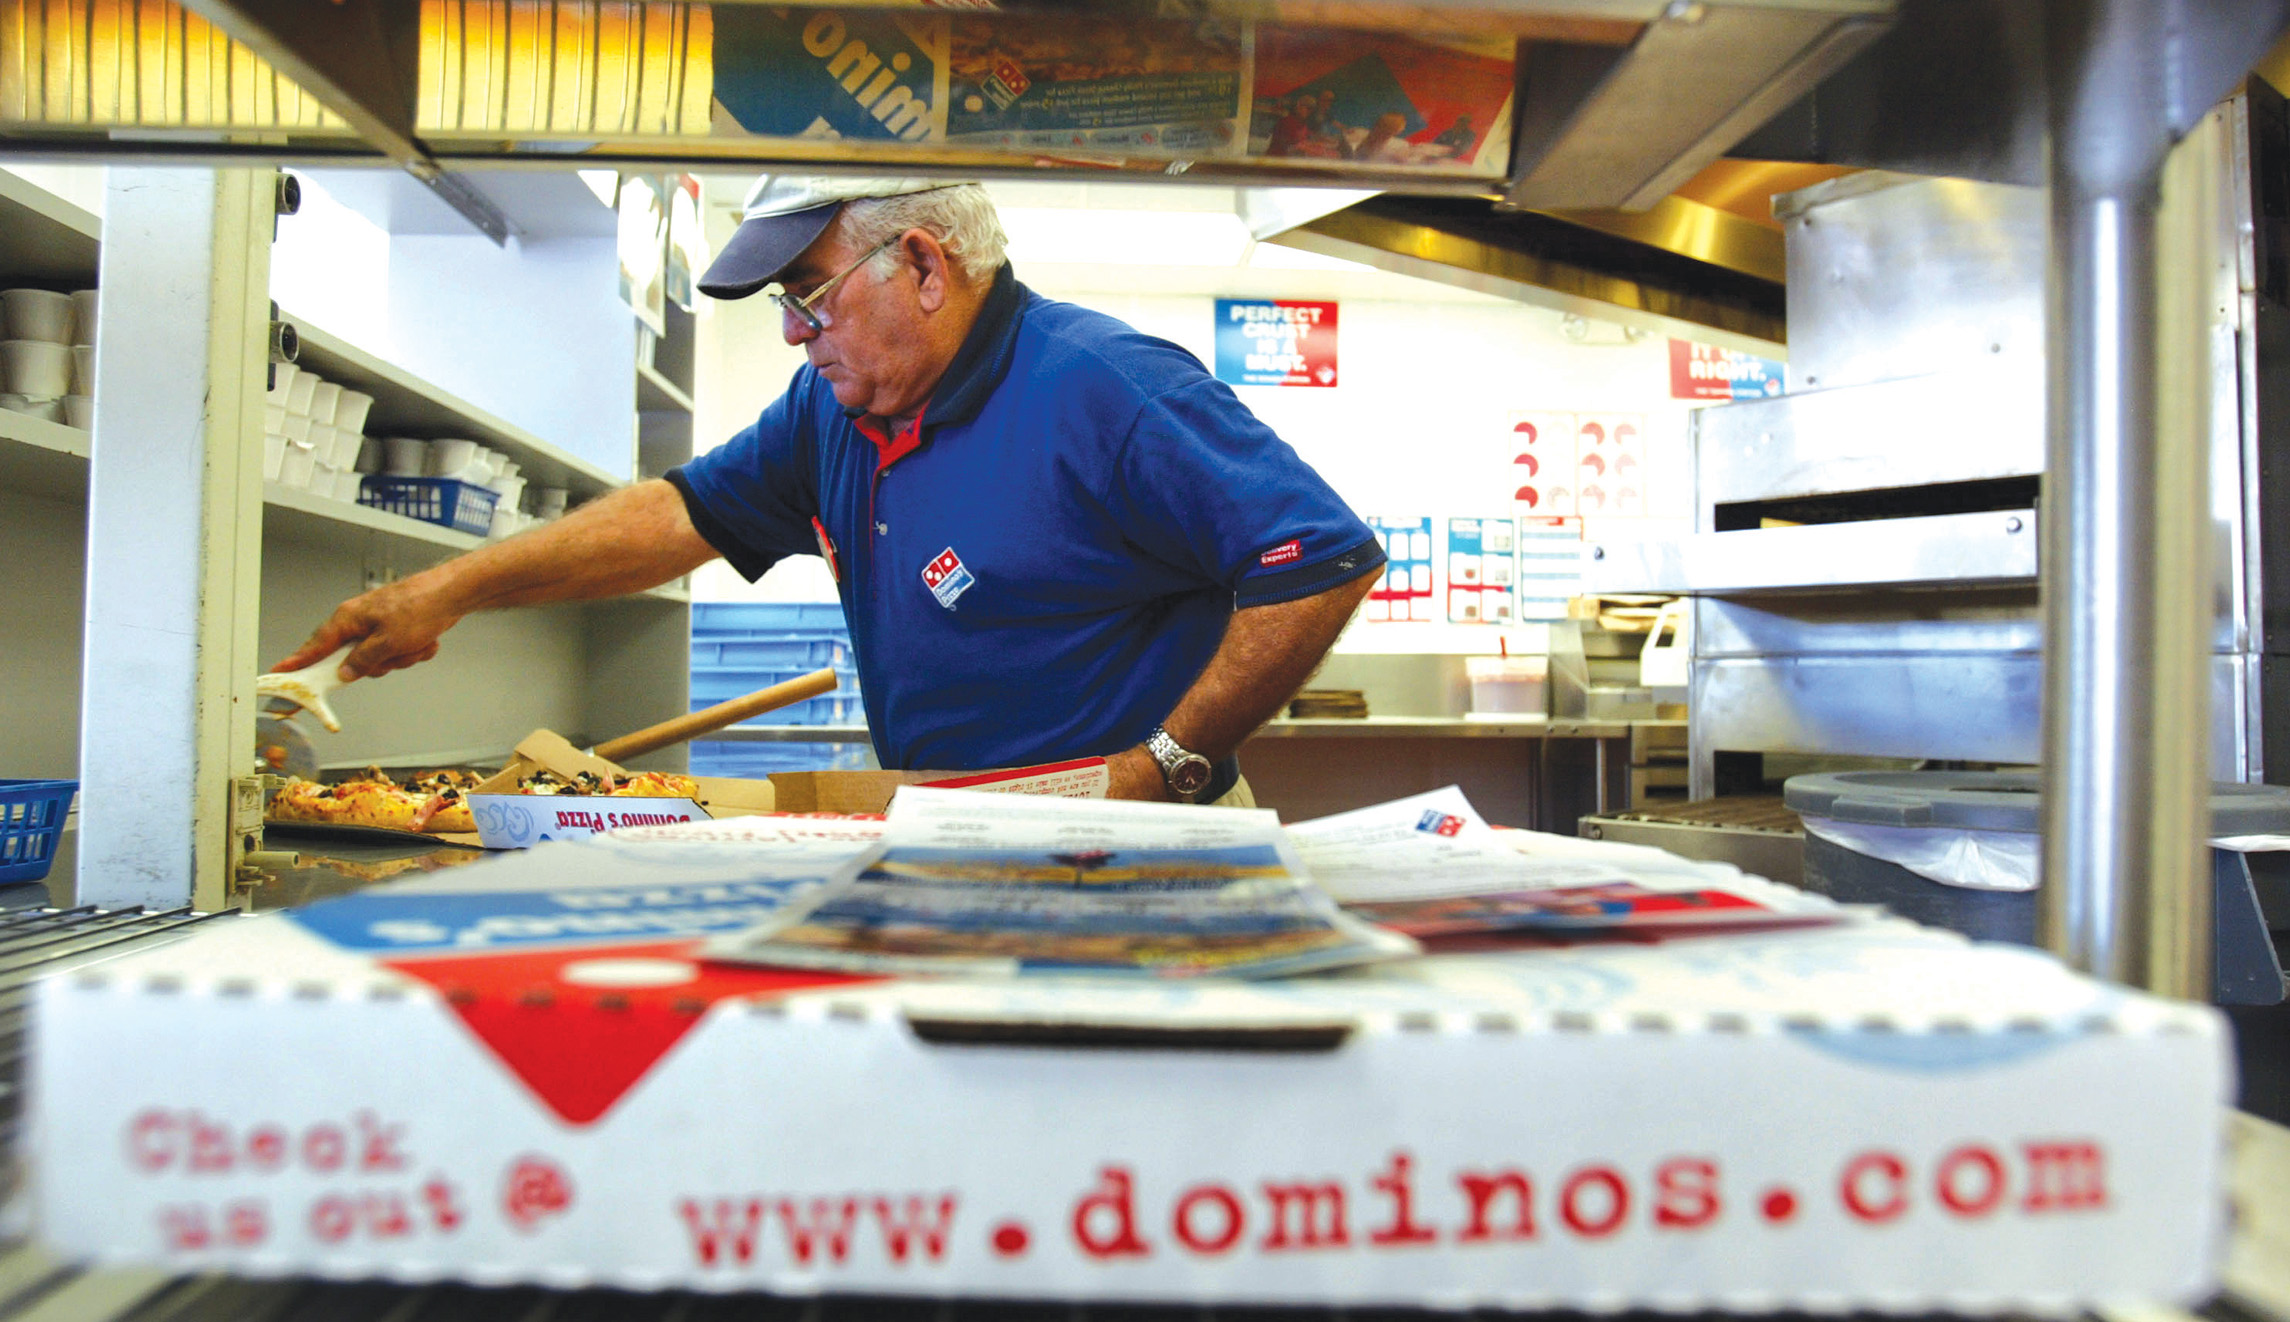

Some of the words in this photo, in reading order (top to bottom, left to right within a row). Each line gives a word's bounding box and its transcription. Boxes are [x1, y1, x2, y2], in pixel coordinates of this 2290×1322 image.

[1230, 304, 1324, 324] PERFECT
[1241, 321, 1312, 340] CRUST
[1689, 359, 1768, 381] RIGHT.
[556, 811, 606, 834] Pizza
[126, 1106, 410, 1174] Check
[160, 1203, 265, 1250] us
[309, 1172, 462, 1245] out
[500, 1151, 580, 1236] @
[674, 1138, 2112, 1268] www.dominos.com
